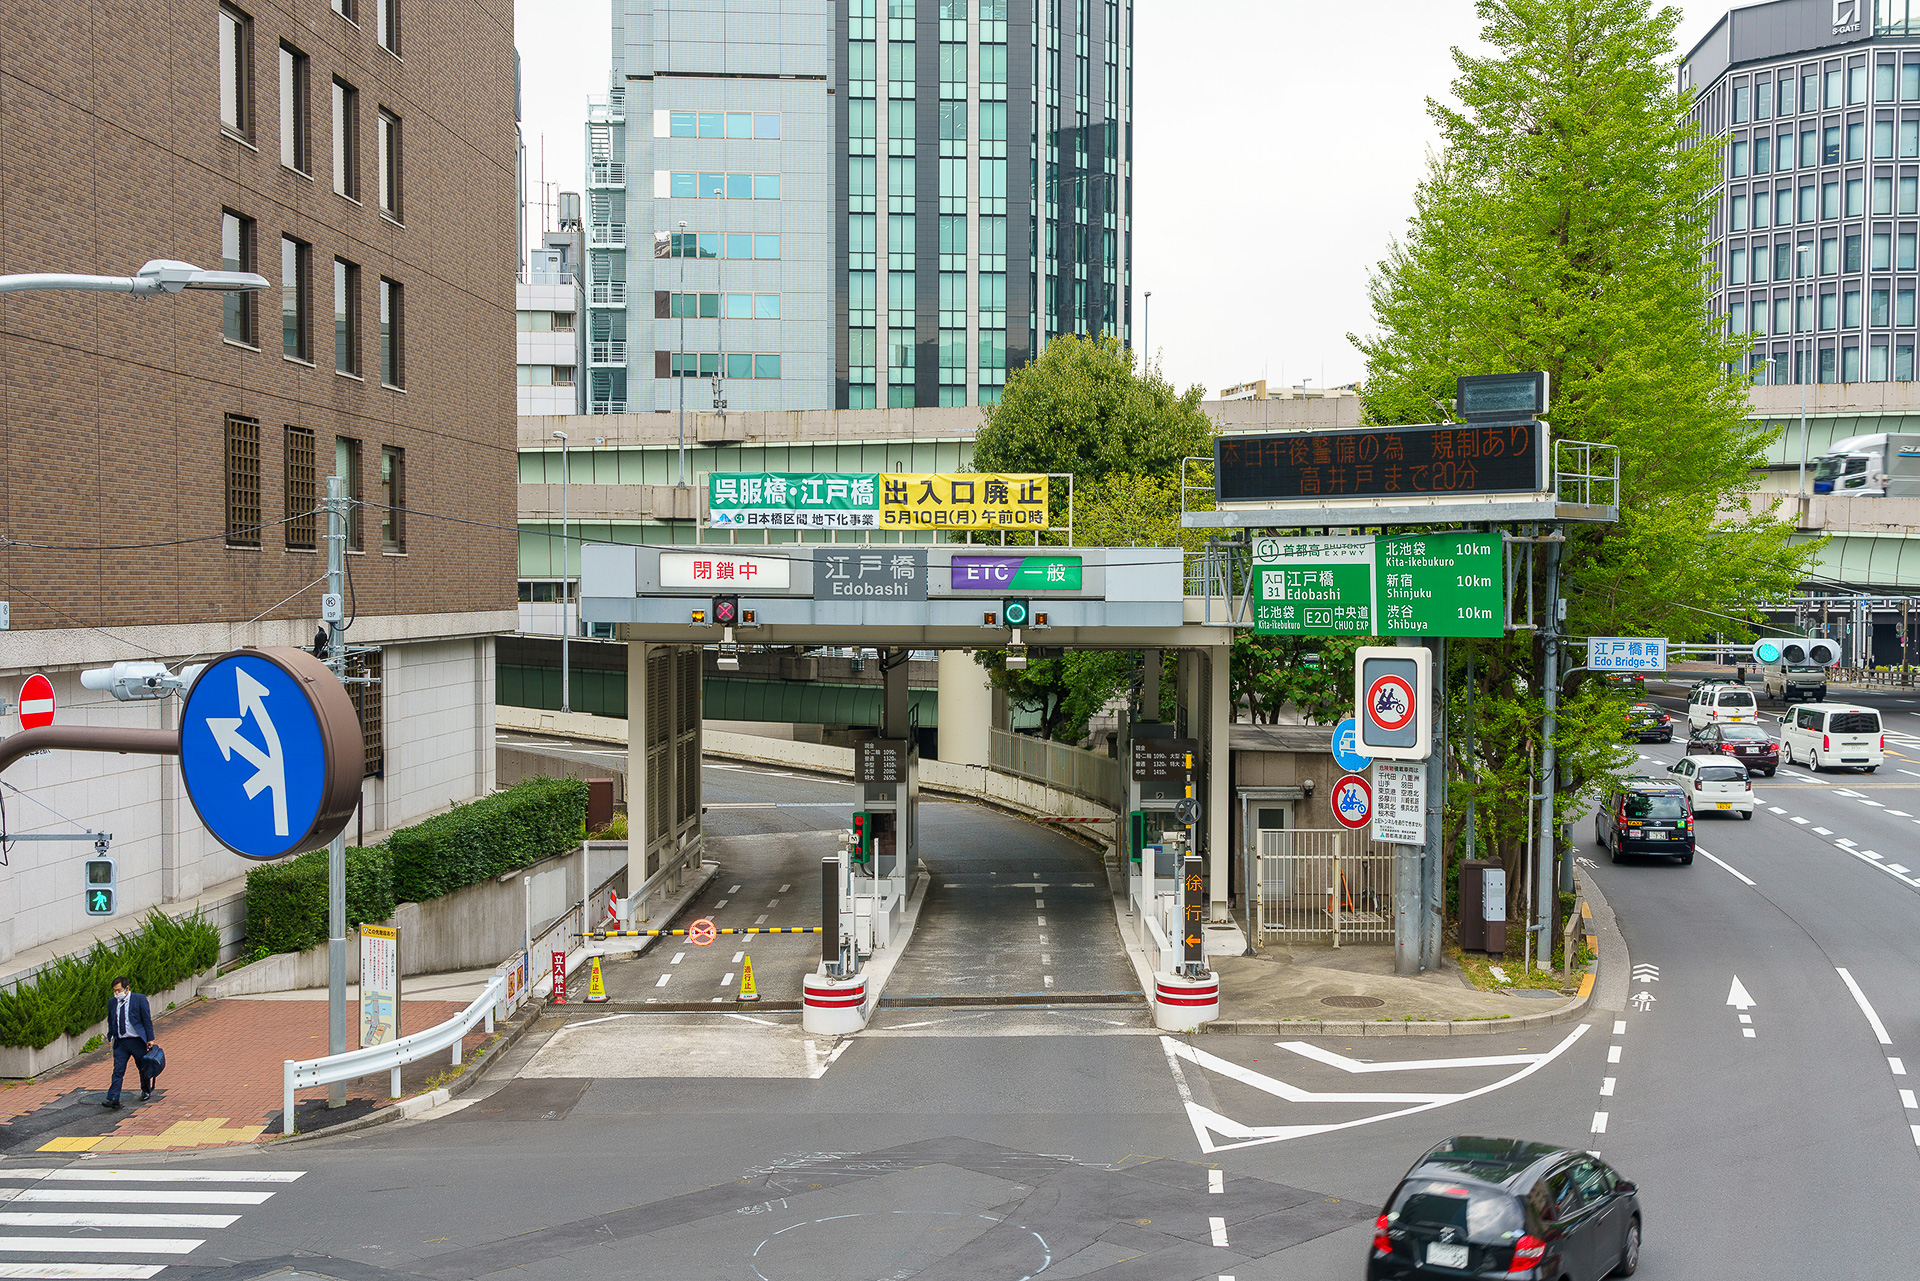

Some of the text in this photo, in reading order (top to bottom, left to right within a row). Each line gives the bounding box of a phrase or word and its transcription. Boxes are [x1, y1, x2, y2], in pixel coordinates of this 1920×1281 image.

[1832, 23, 1861, 35] S-GATE
[1221, 425, 1529, 468] 本日午後警備の為 規制あり
[1299, 459, 1479, 495] 高井戸まで20分
[715, 477, 874, 506] 呉服橋・江戸橋
[884, 479, 1043, 506] 出入口廃止
[747, 513, 808, 526] 日本橋区間
[812, 513, 874, 526] 地下化事業
[884, 509, 1043, 525] 5月10日(月) 午前0時
[1261, 543, 1320, 558] C1 首都高
[1386, 542, 1491, 556] 北池袋 10km
[825, 554, 916, 580] 江戸橋
[1386, 556, 1455, 567] Kita-ikebukuro
[693, 561, 758, 580] 閉鎖中
[967, 563, 1066, 582] ETC 一般
[1264, 573, 1283, 584] 入口
[1287, 570, 1334, 587] 江戸橋
[1386, 573, 1492, 587] 新宿 10km
[832, 582, 909, 596] Edobashi
[1268, 586, 1281, 597] 31
[1287, 588, 1341, 600] Edobashi
[1387, 588, 1432, 600] Shinjuku
[1258, 605, 1295, 619] 北池袋
[1306, 611, 1330, 624] E20
[1334, 605, 1369, 620] 中央道
[1387, 604, 1492, 619] 渋谷 10km
[1258, 619, 1301, 630] Kita-ikebukuro
[1334, 620, 1369, 630] CHUO EXP
[1387, 619, 1428, 631] Shibuya
[1594, 642, 1659, 656] 江戸橋南
[1594, 656, 1660, 668] Edo Bridge-S.
[1185, 874, 1203, 921] 徐行
[554, 954, 564, 994] 立入禁止
[592, 967, 600, 991] 通行止
